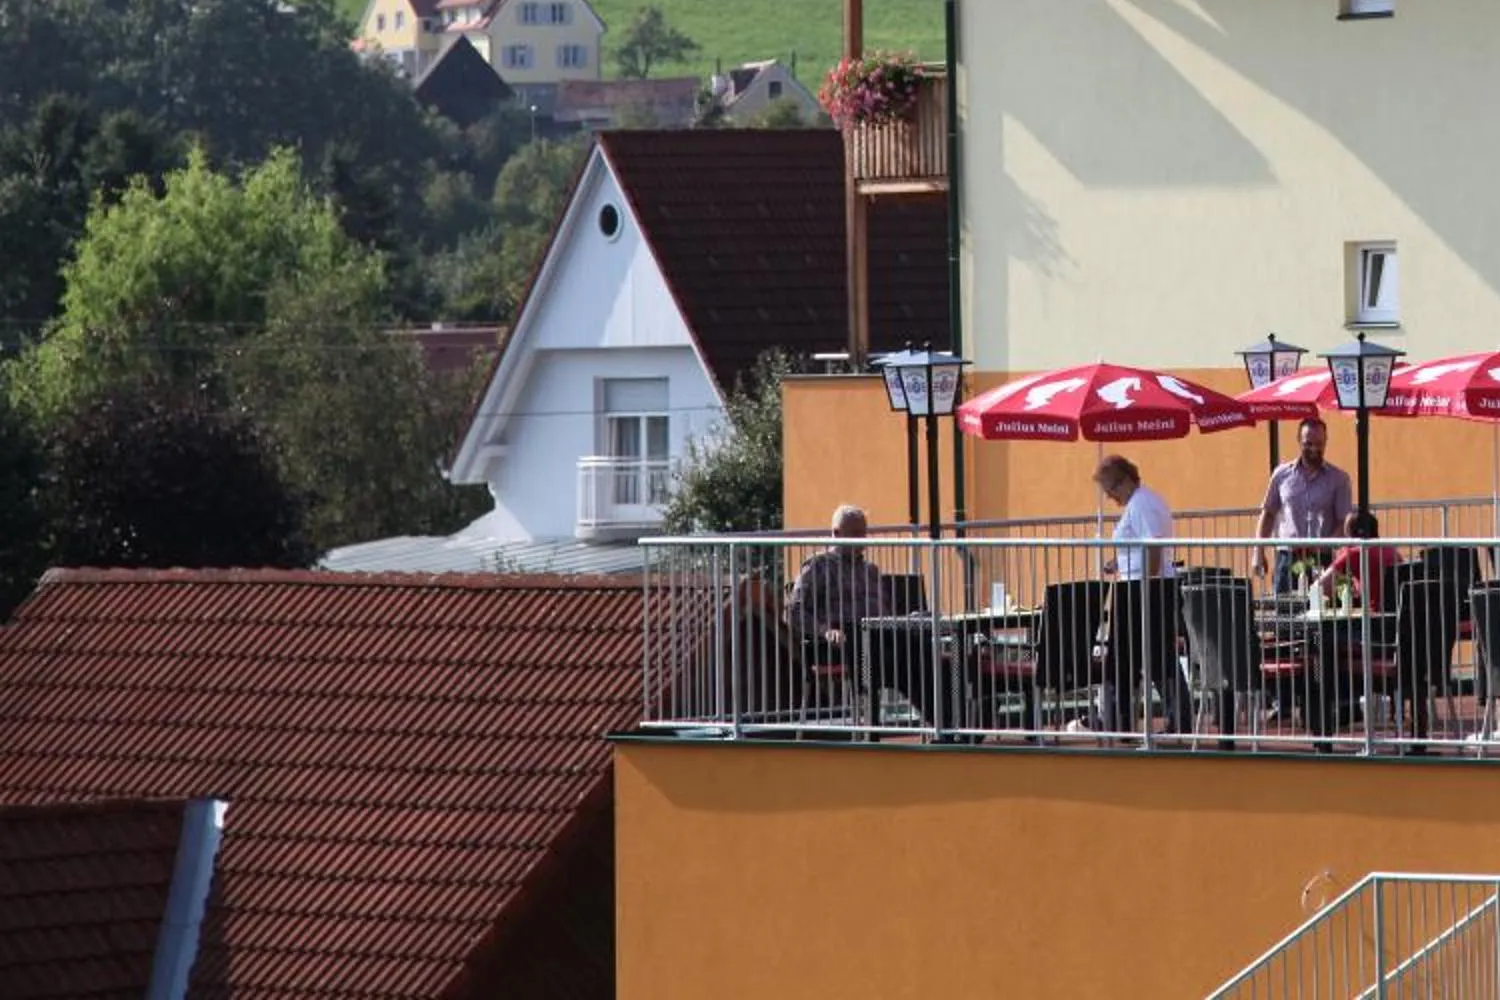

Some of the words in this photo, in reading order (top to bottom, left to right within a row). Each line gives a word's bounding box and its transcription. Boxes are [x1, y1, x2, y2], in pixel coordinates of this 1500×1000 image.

[995, 420, 1034, 433] Julius
[1037, 421, 1069, 434] Meinl
[1094, 420, 1133, 433] Julius
[1137, 417, 1174, 432] Meinl
